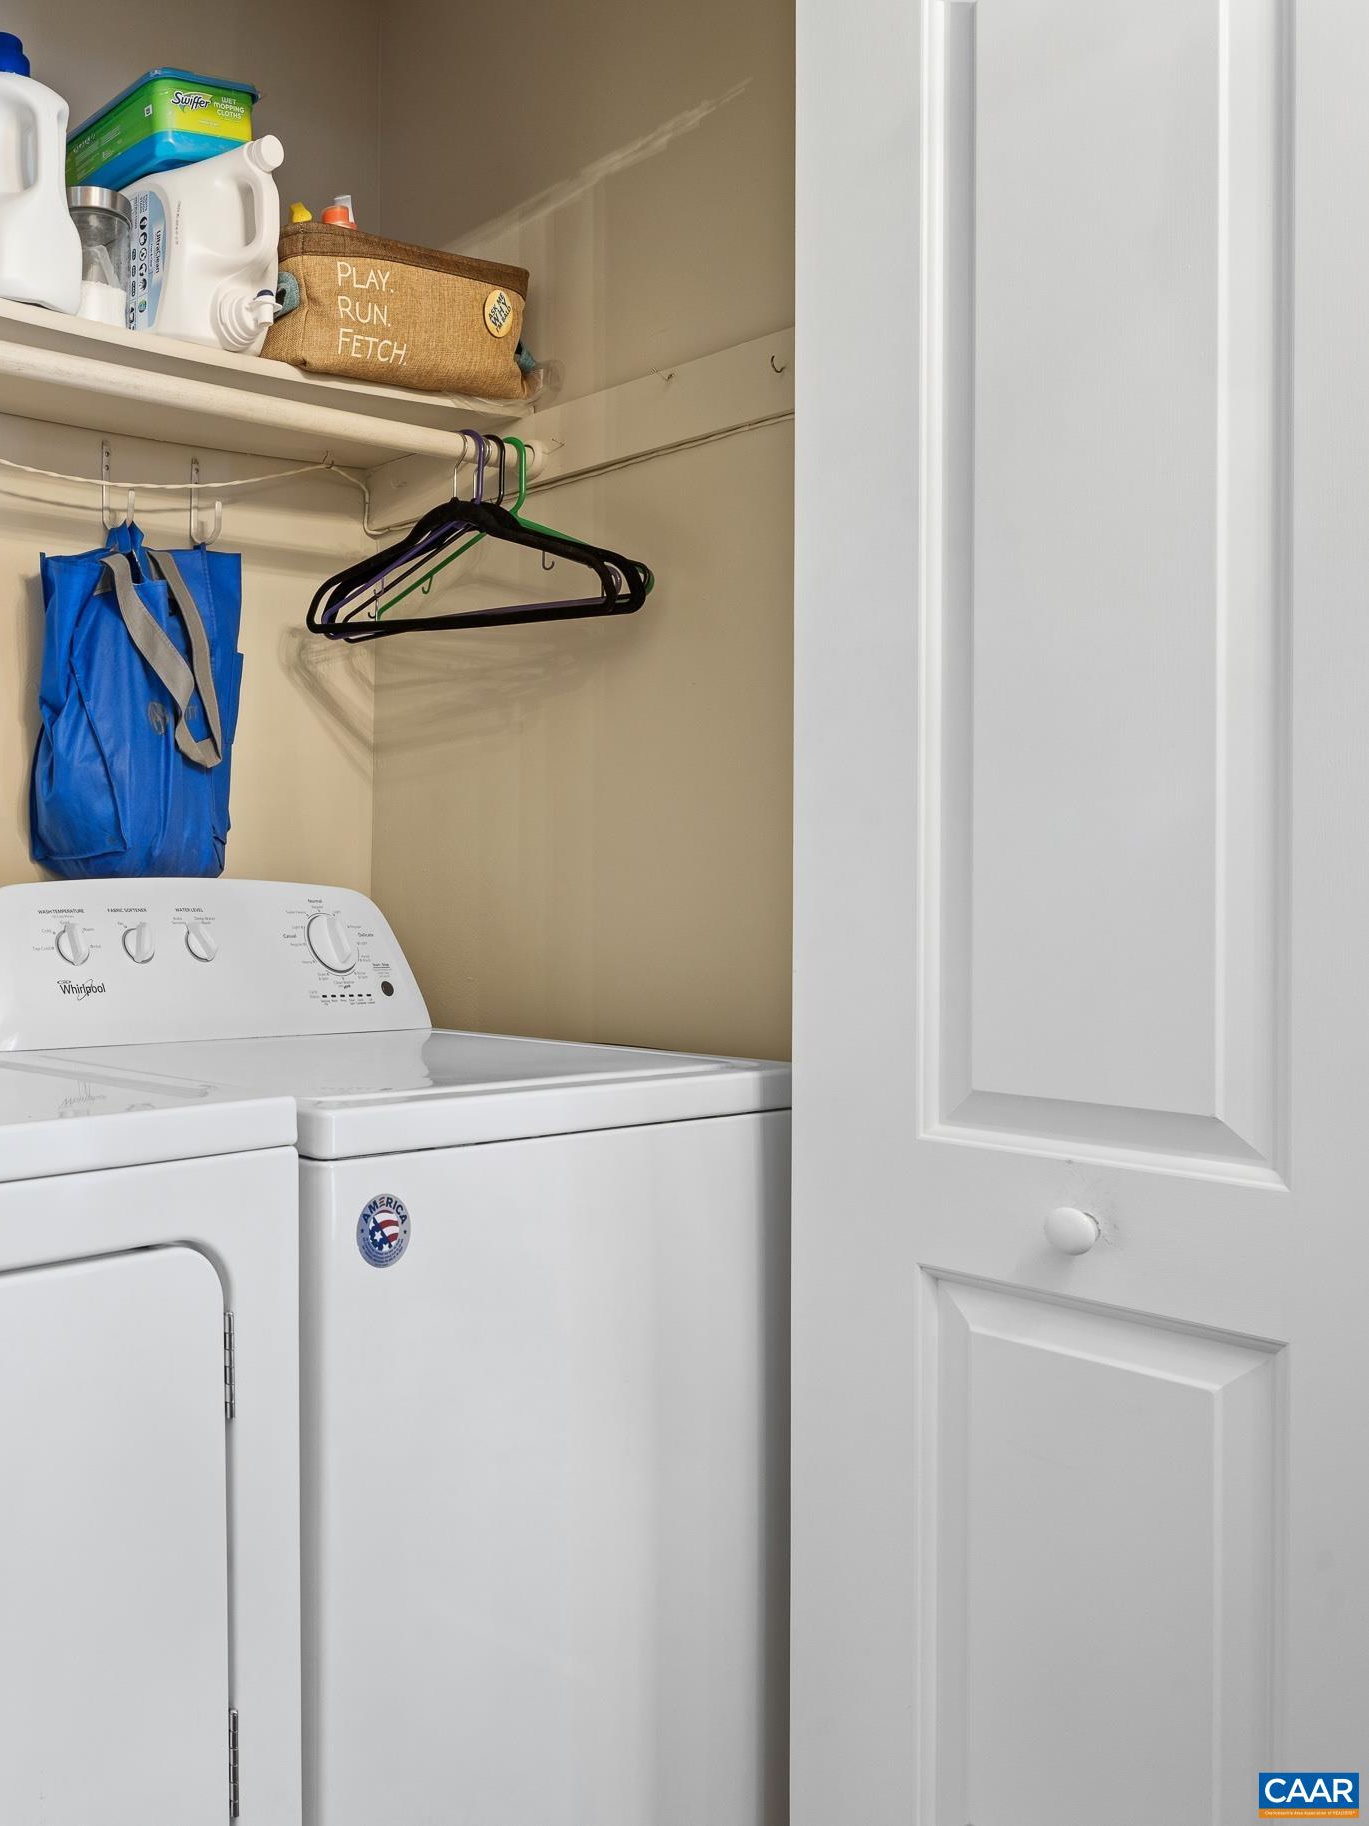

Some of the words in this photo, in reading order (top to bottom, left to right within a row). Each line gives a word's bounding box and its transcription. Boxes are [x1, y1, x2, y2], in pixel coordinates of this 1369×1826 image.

[171, 90, 212, 110] Swiffer
[217, 110, 242, 120] CLOTHS
[336, 261, 395, 294] PLAY.
[338, 295, 391, 328] RUN.
[337, 328, 408, 366] FETCH.
[59, 980, 106, 998] Whirlpool
[362, 1196, 408, 1224] AMERICA
